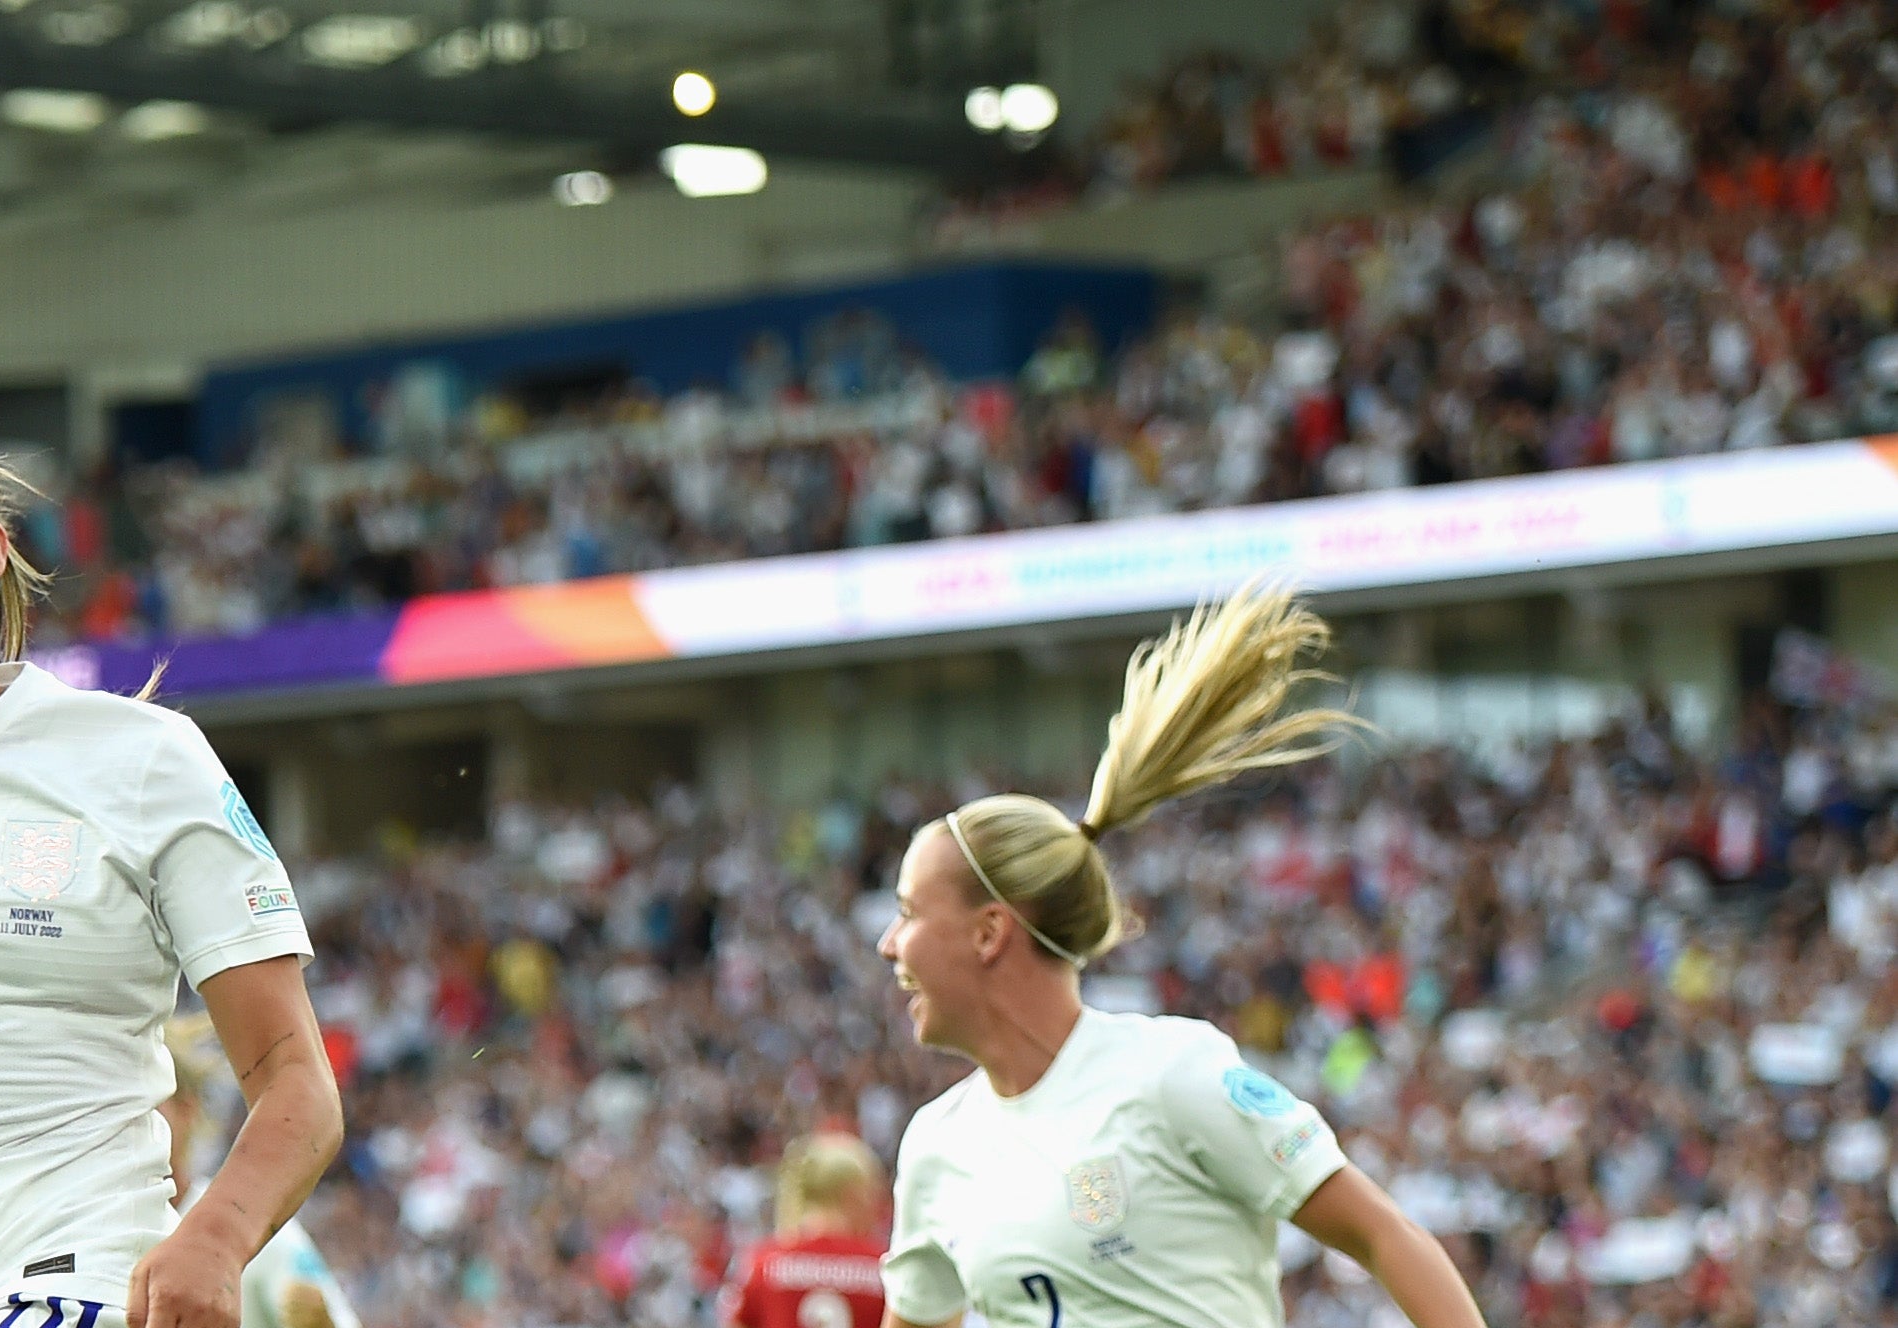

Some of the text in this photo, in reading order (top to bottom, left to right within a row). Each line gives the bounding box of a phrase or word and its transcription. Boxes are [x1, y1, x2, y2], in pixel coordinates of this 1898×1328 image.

[245, 885, 268, 897] UEFA
[10, 908, 54, 922] NORWAY
[11, 922, 39, 936] JULY
[39, 925, 62, 939] 2022
